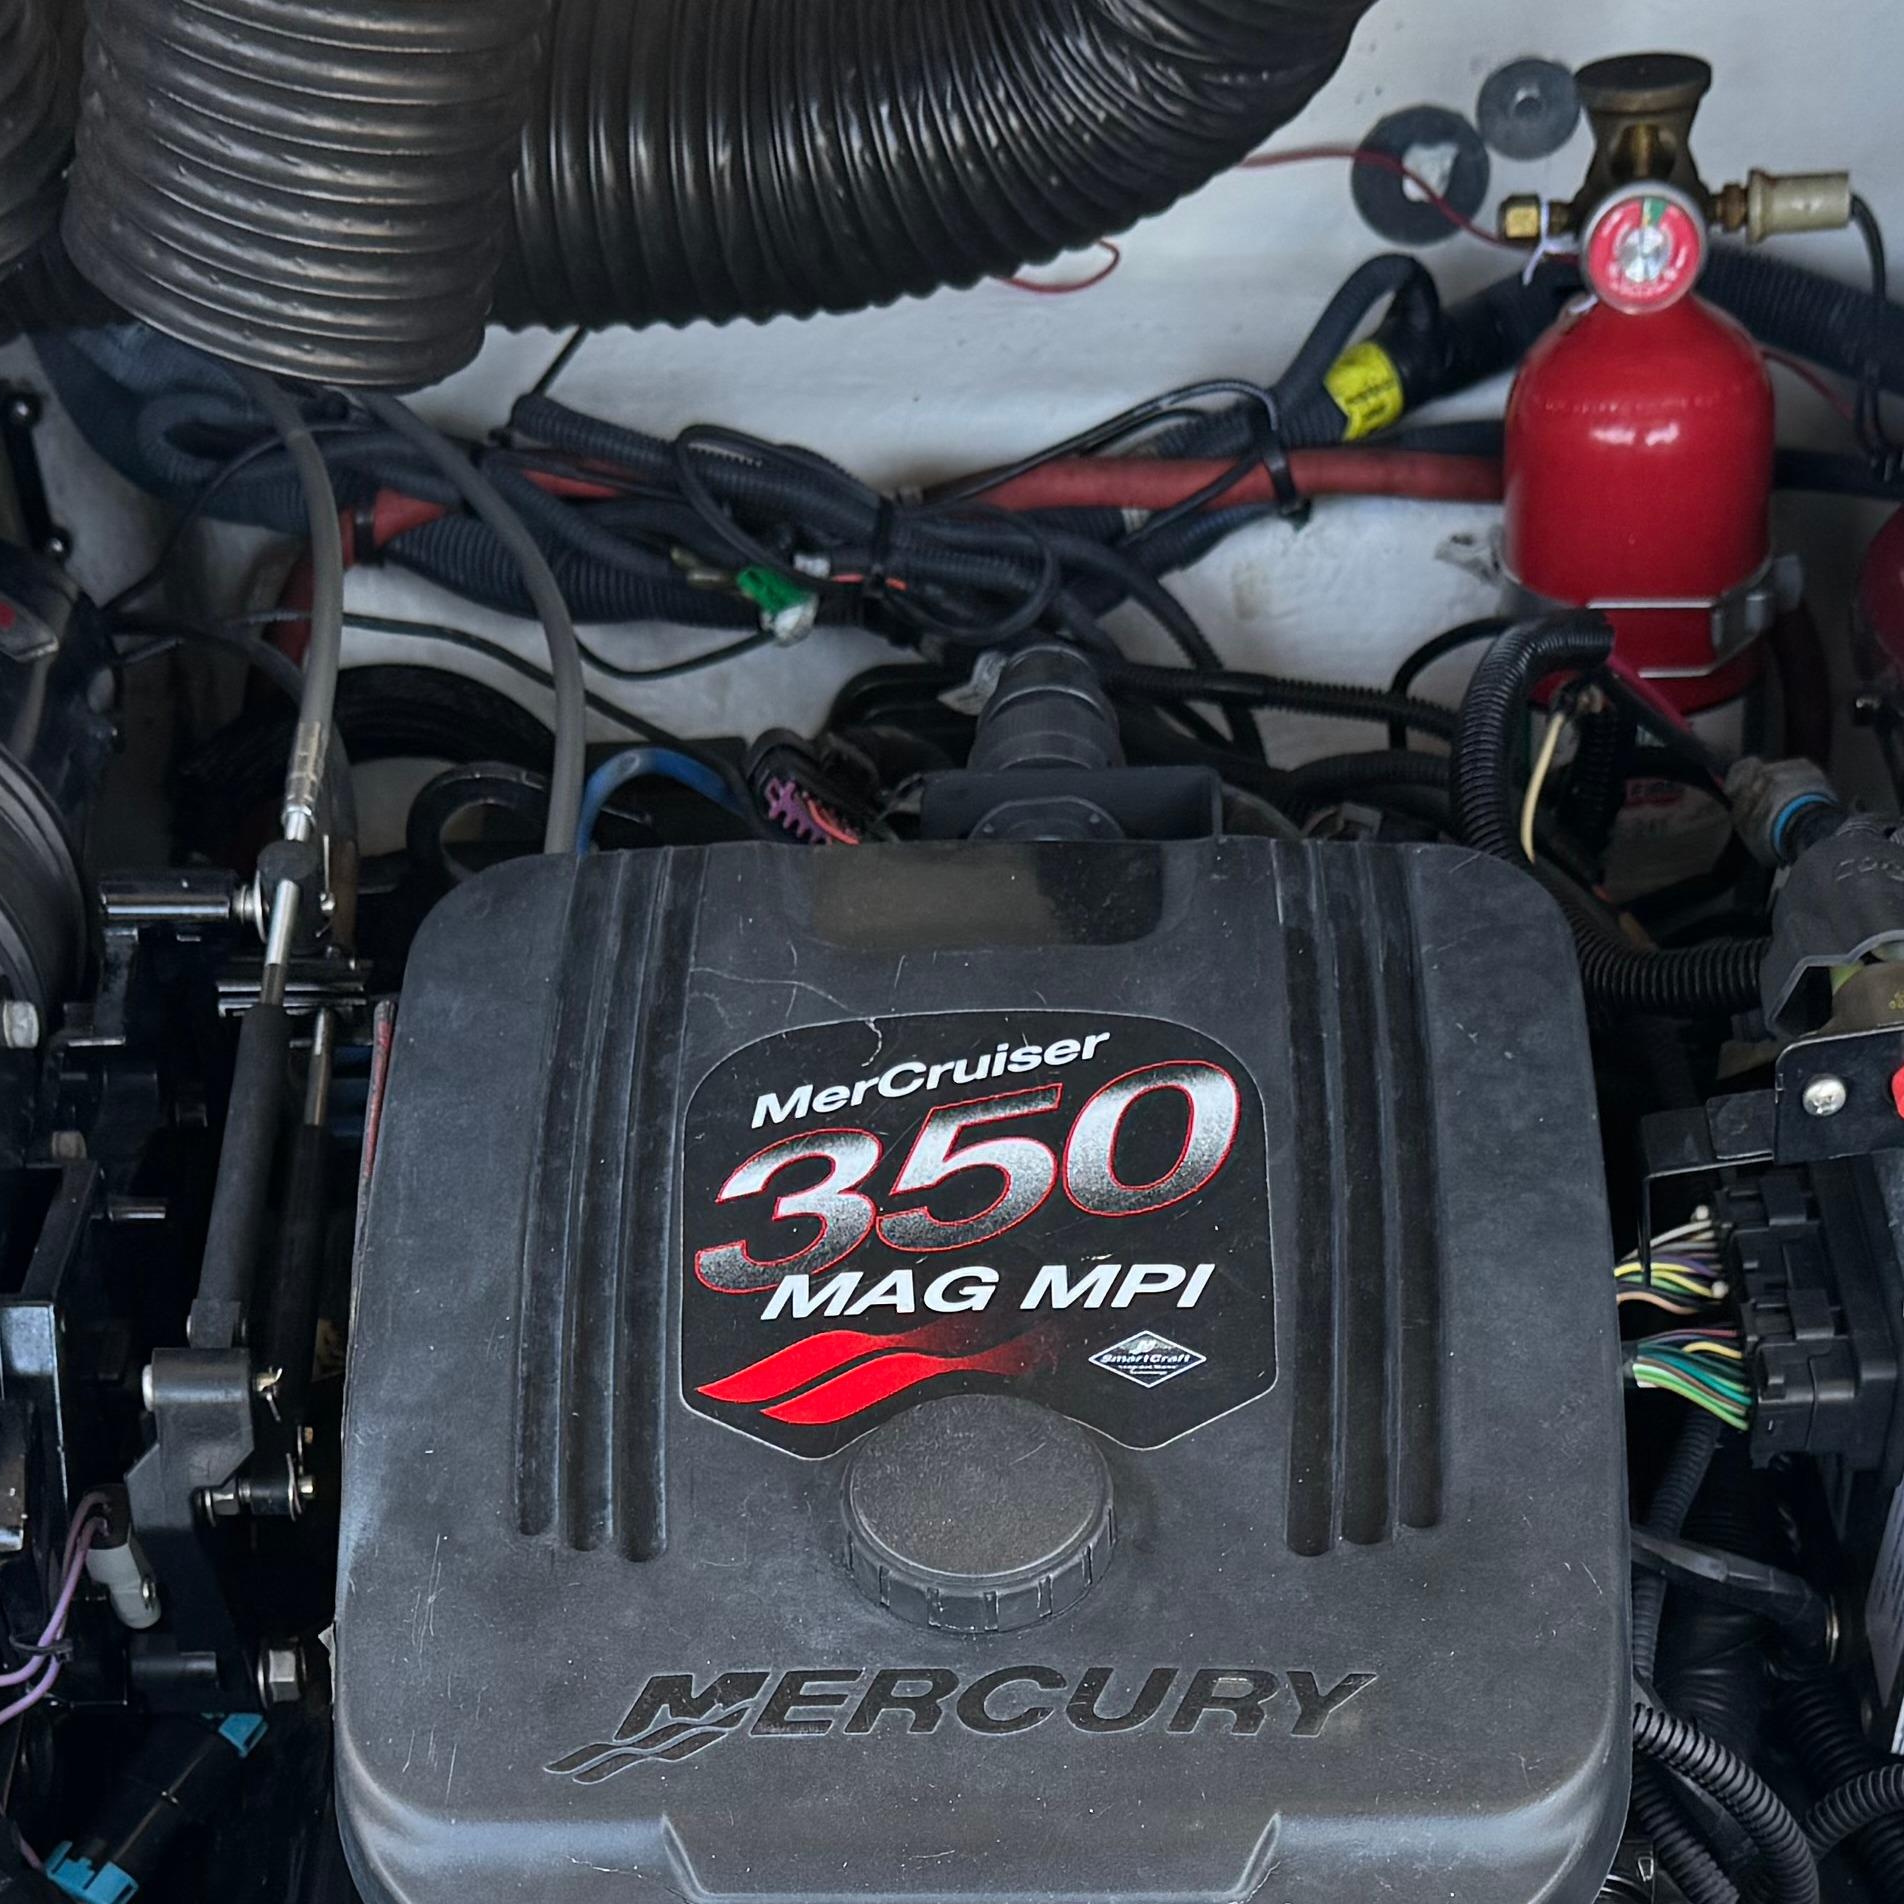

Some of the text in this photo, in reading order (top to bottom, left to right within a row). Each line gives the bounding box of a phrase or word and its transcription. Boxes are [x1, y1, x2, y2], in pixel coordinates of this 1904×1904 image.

[752, 1028, 1110, 1129] MerCruiser
[694, 1059, 1241, 1294] 350
[760, 1262, 1215, 1320] MAG MPI
[591, 1663, 1380, 1748] MERCURY
